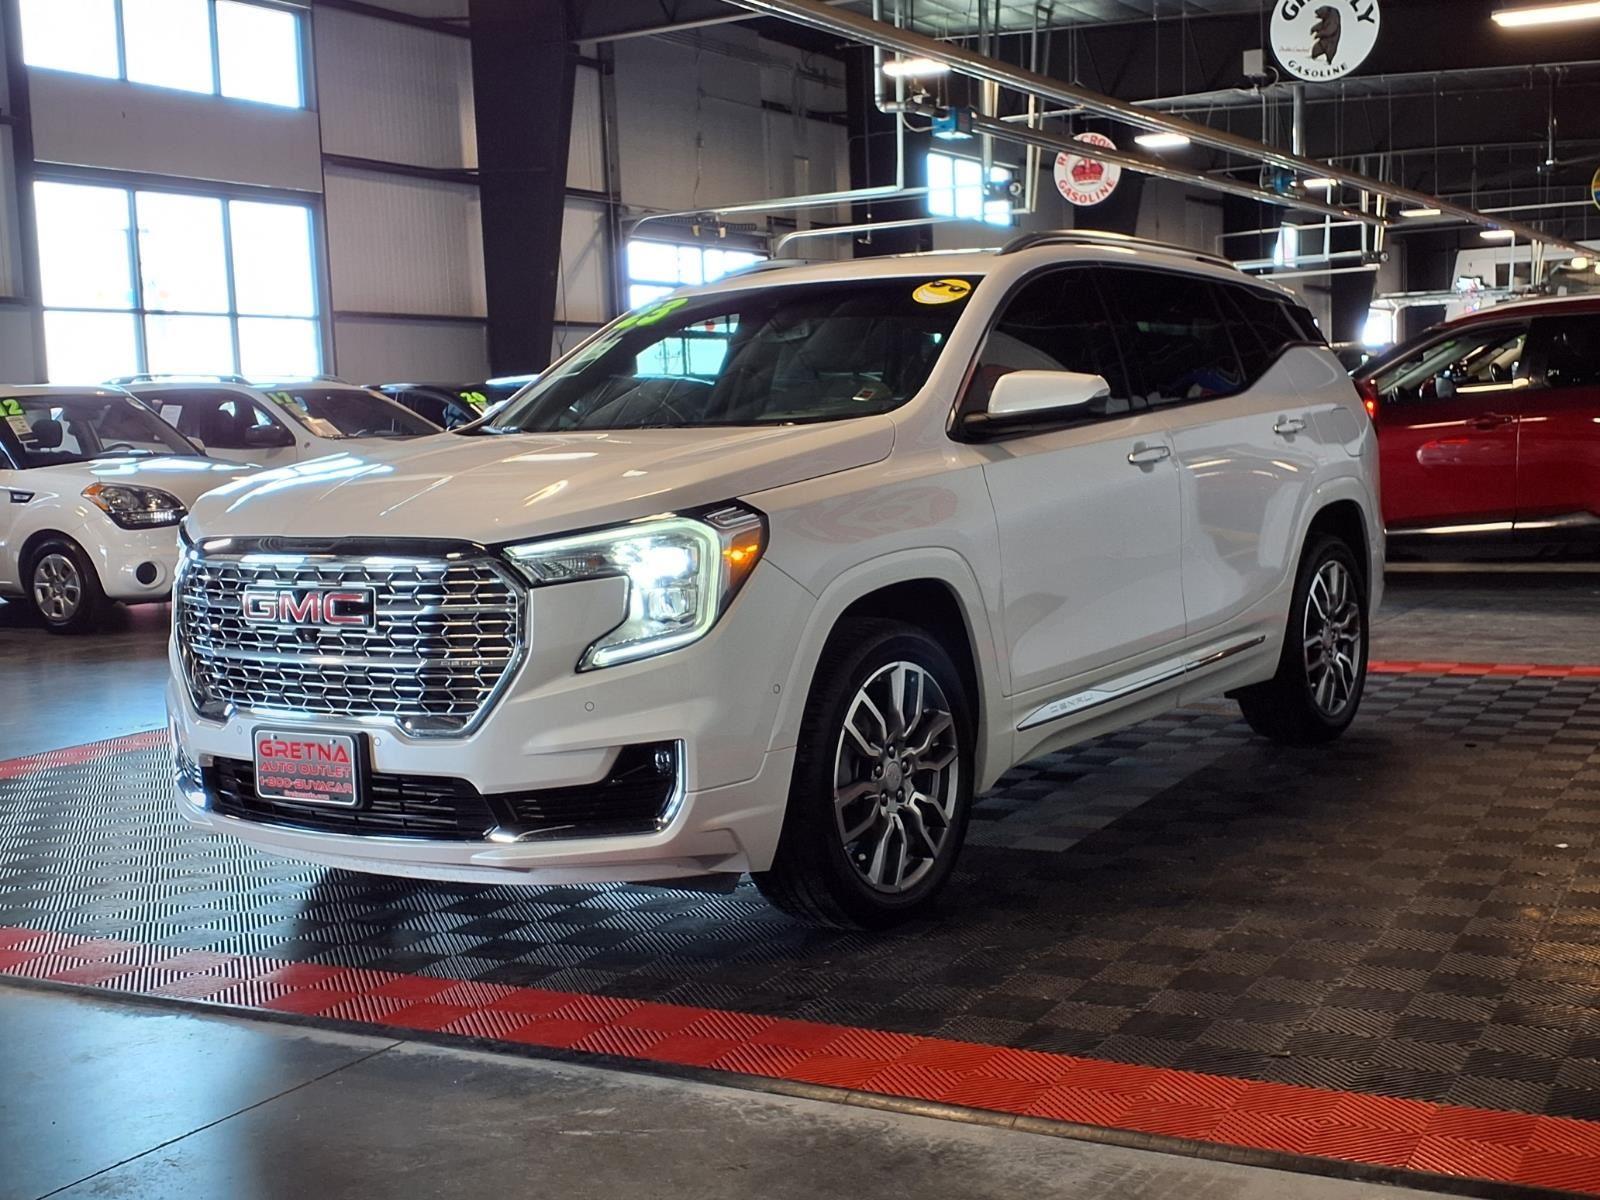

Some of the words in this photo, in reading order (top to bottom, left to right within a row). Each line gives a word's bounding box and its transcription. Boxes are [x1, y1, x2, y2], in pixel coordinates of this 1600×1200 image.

[1288, 60, 1347, 78] GASOLINE
[1059, 179, 1116, 203] GASOLINE
[243, 590, 365, 625] GMC
[259, 739, 349, 763] GRETNA
[261, 761, 297, 774] AUTO
[299, 763, 351, 778] OUTLET
